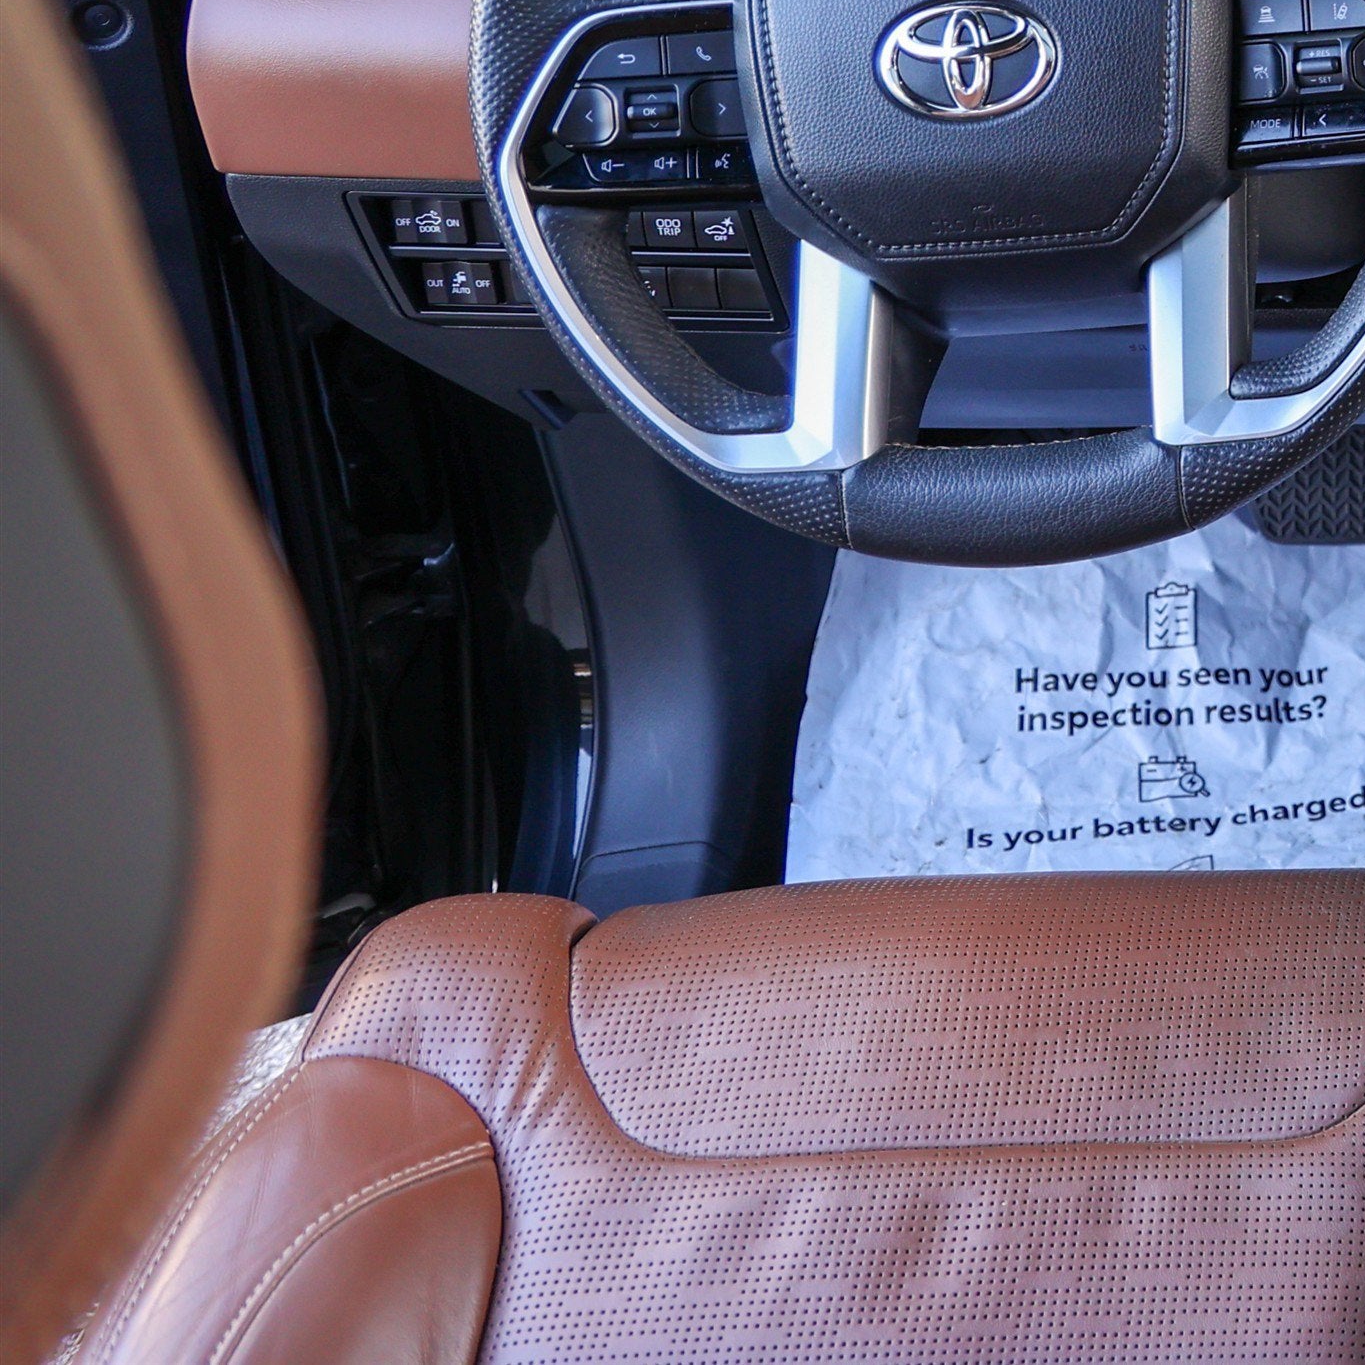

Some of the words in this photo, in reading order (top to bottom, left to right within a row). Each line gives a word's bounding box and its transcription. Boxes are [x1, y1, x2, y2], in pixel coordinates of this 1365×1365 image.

[643, 107, 657, 116] OK
[1250, 118, 1282, 129] MODE
[395, 218, 411, 226] OFF
[446, 219, 460, 227] ON
[655, 218, 681, 227] ODO
[657, 227, 681, 236] TRIP
[426, 279, 444, 287] OUT
[475, 280, 491, 288] OFF
[1014, 667, 1098, 693] Have
[1105, 669, 1168, 698] you
[1177, 666, 1251, 686] seen
[1258, 666, 1328, 692] your
[1017, 699, 1194, 736] inspection
[1204, 694, 1327, 725] results?
[966, 827, 993, 849] Is
[1002, 822, 1083, 852] your
[1093, 812, 1222, 838] battery
